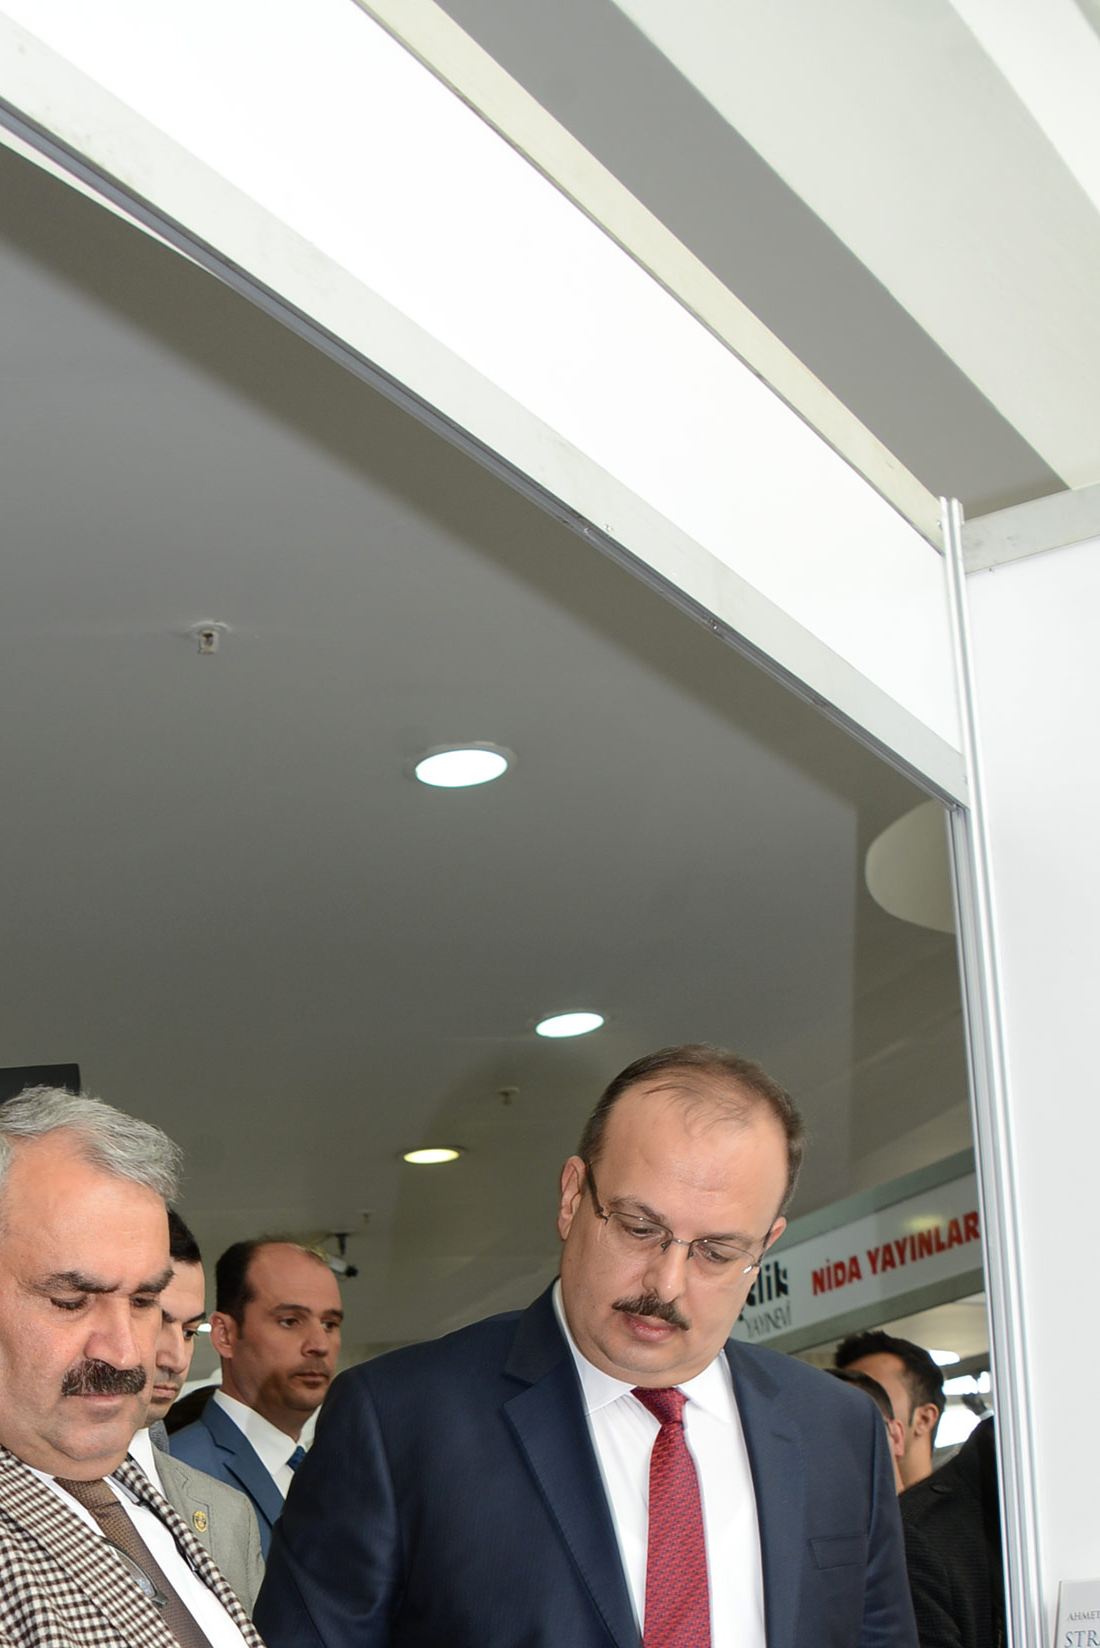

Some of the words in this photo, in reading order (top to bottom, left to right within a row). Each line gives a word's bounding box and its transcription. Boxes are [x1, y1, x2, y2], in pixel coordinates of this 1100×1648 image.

[811, 1254, 863, 1297] NİDA
[865, 1209, 981, 1277] YAYINLAR
[1064, 1629, 1100, 1648] STR
